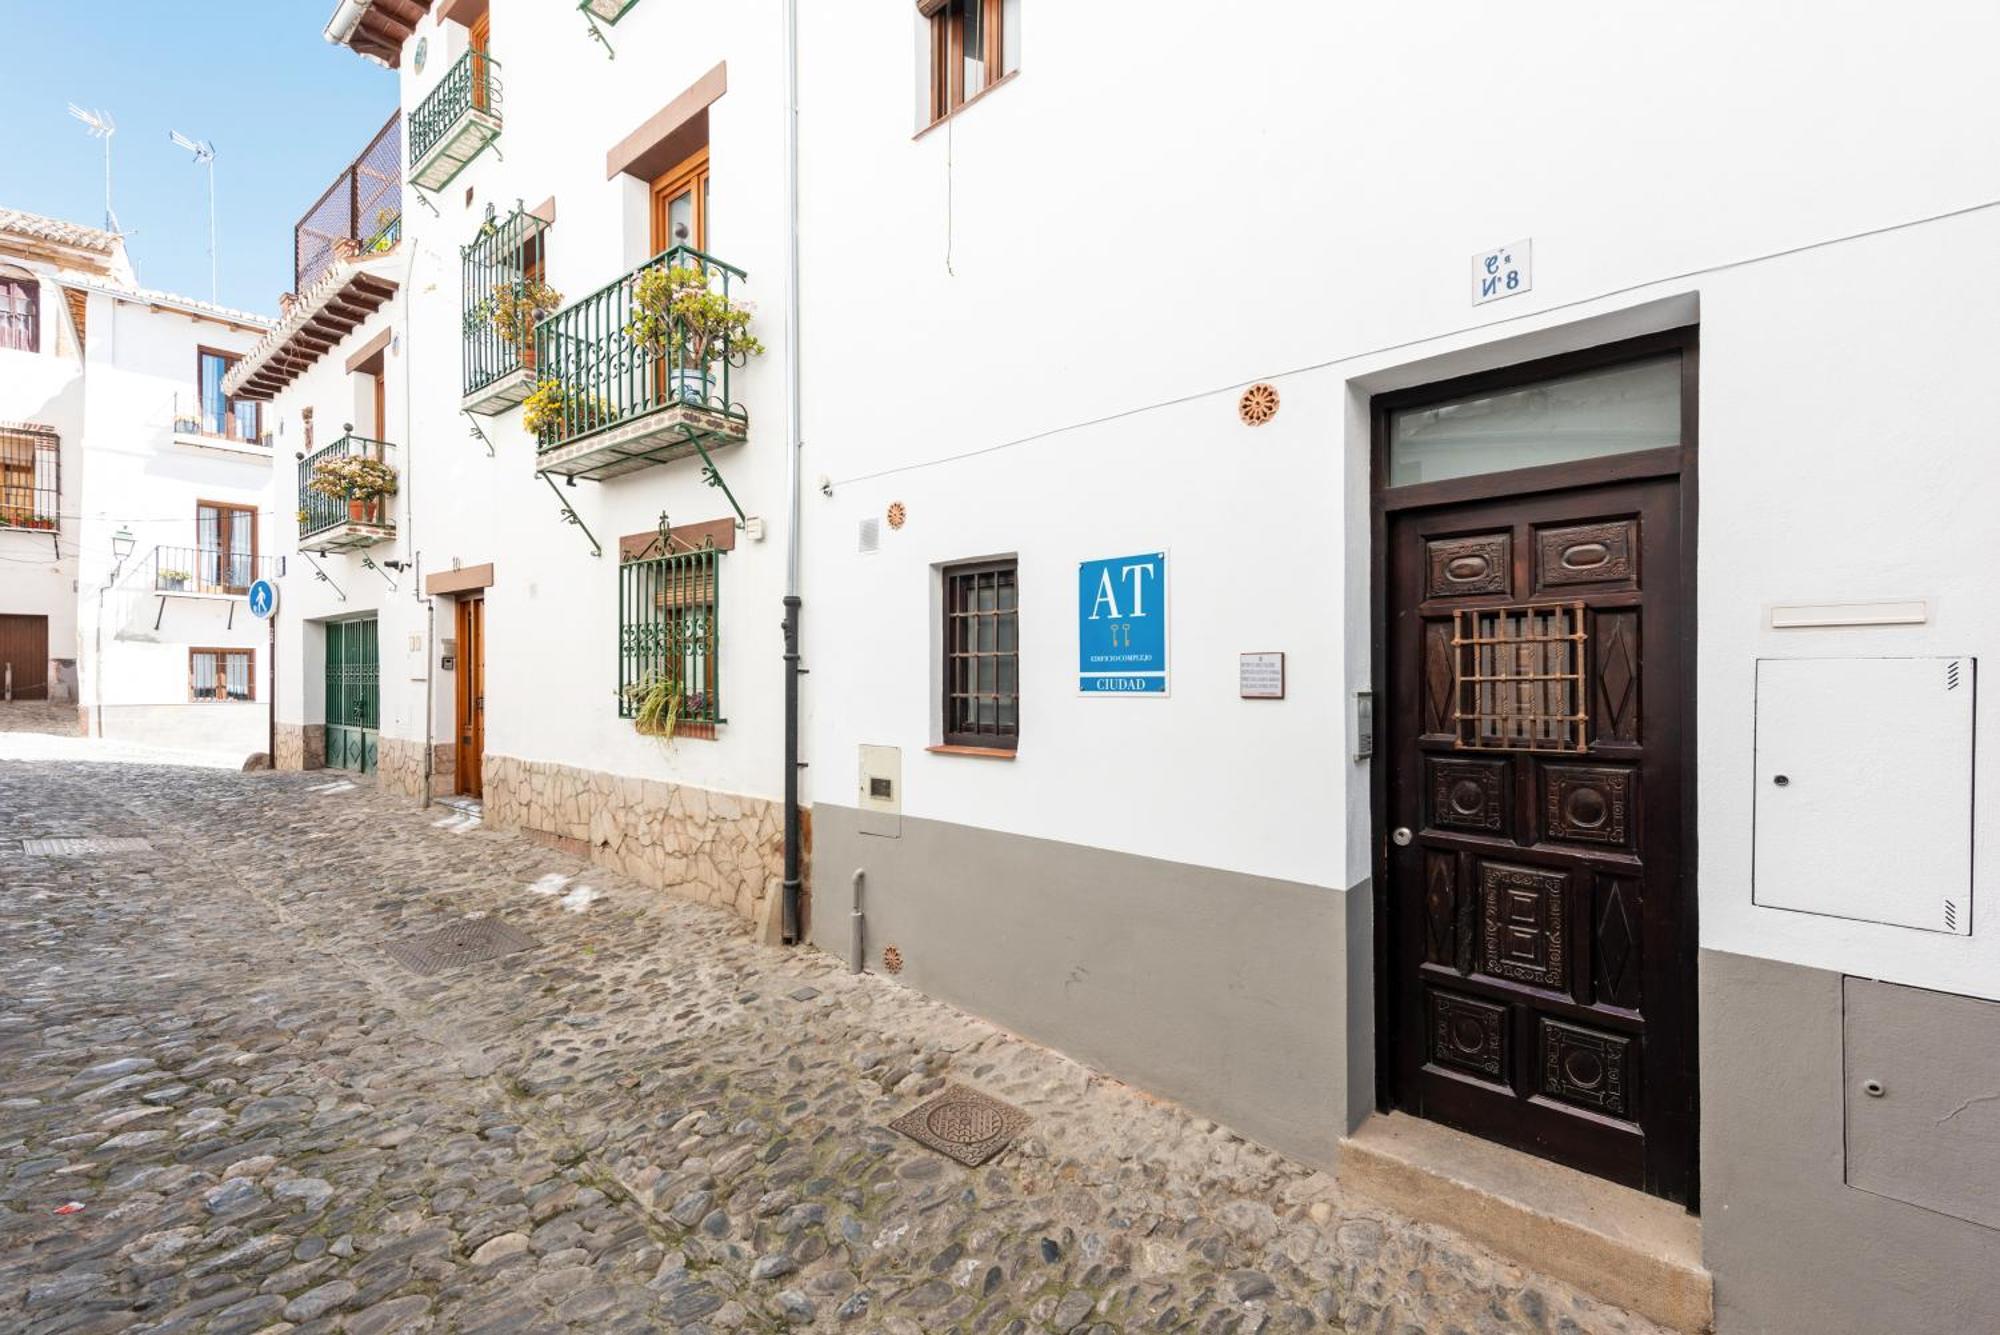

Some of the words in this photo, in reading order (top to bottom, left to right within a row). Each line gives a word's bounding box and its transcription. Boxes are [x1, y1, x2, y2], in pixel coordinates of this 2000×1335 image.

[1506, 270, 1519, 290] 8
[1087, 563, 1155, 620] AT
[1096, 678, 1146, 691] CIUDAD
